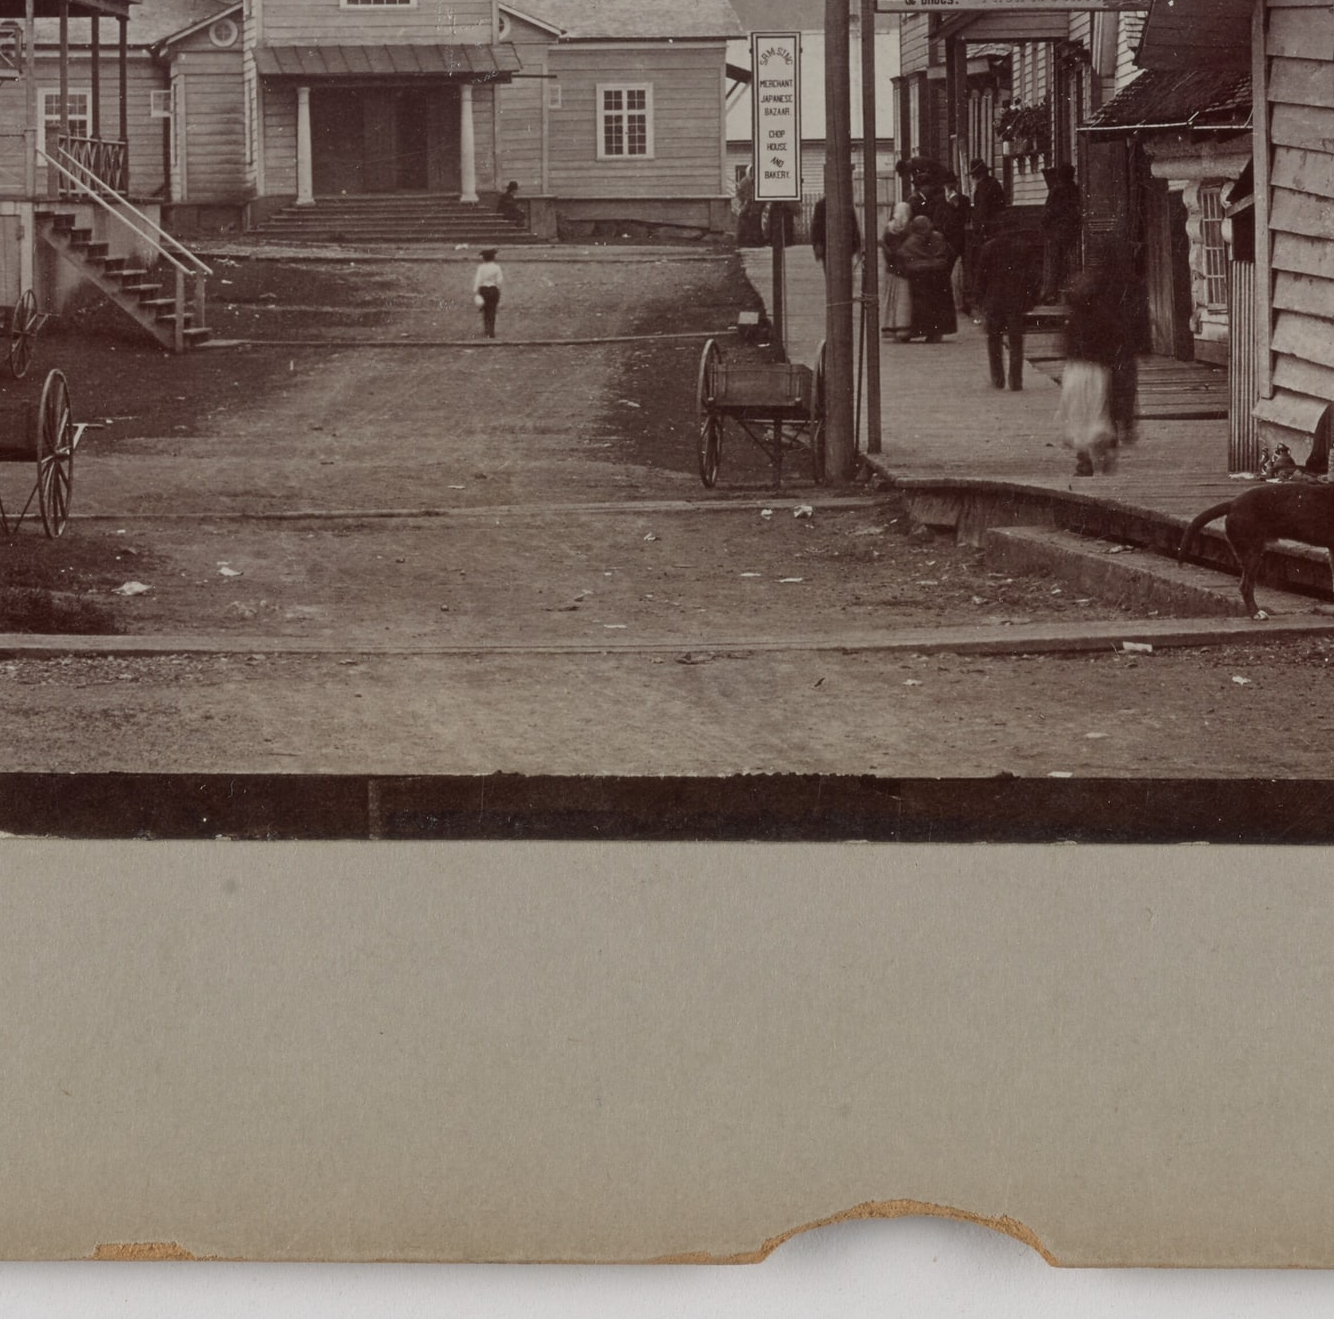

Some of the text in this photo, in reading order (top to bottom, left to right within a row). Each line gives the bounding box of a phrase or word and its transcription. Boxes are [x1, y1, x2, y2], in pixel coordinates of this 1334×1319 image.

[760, 79, 793, 88] MERCHANT
[760, 94, 793, 103] JAPANESE
[769, 129, 786, 138] CHOP
[766, 142, 788, 151] HOUSE
[770, 156, 784, 168] AND
